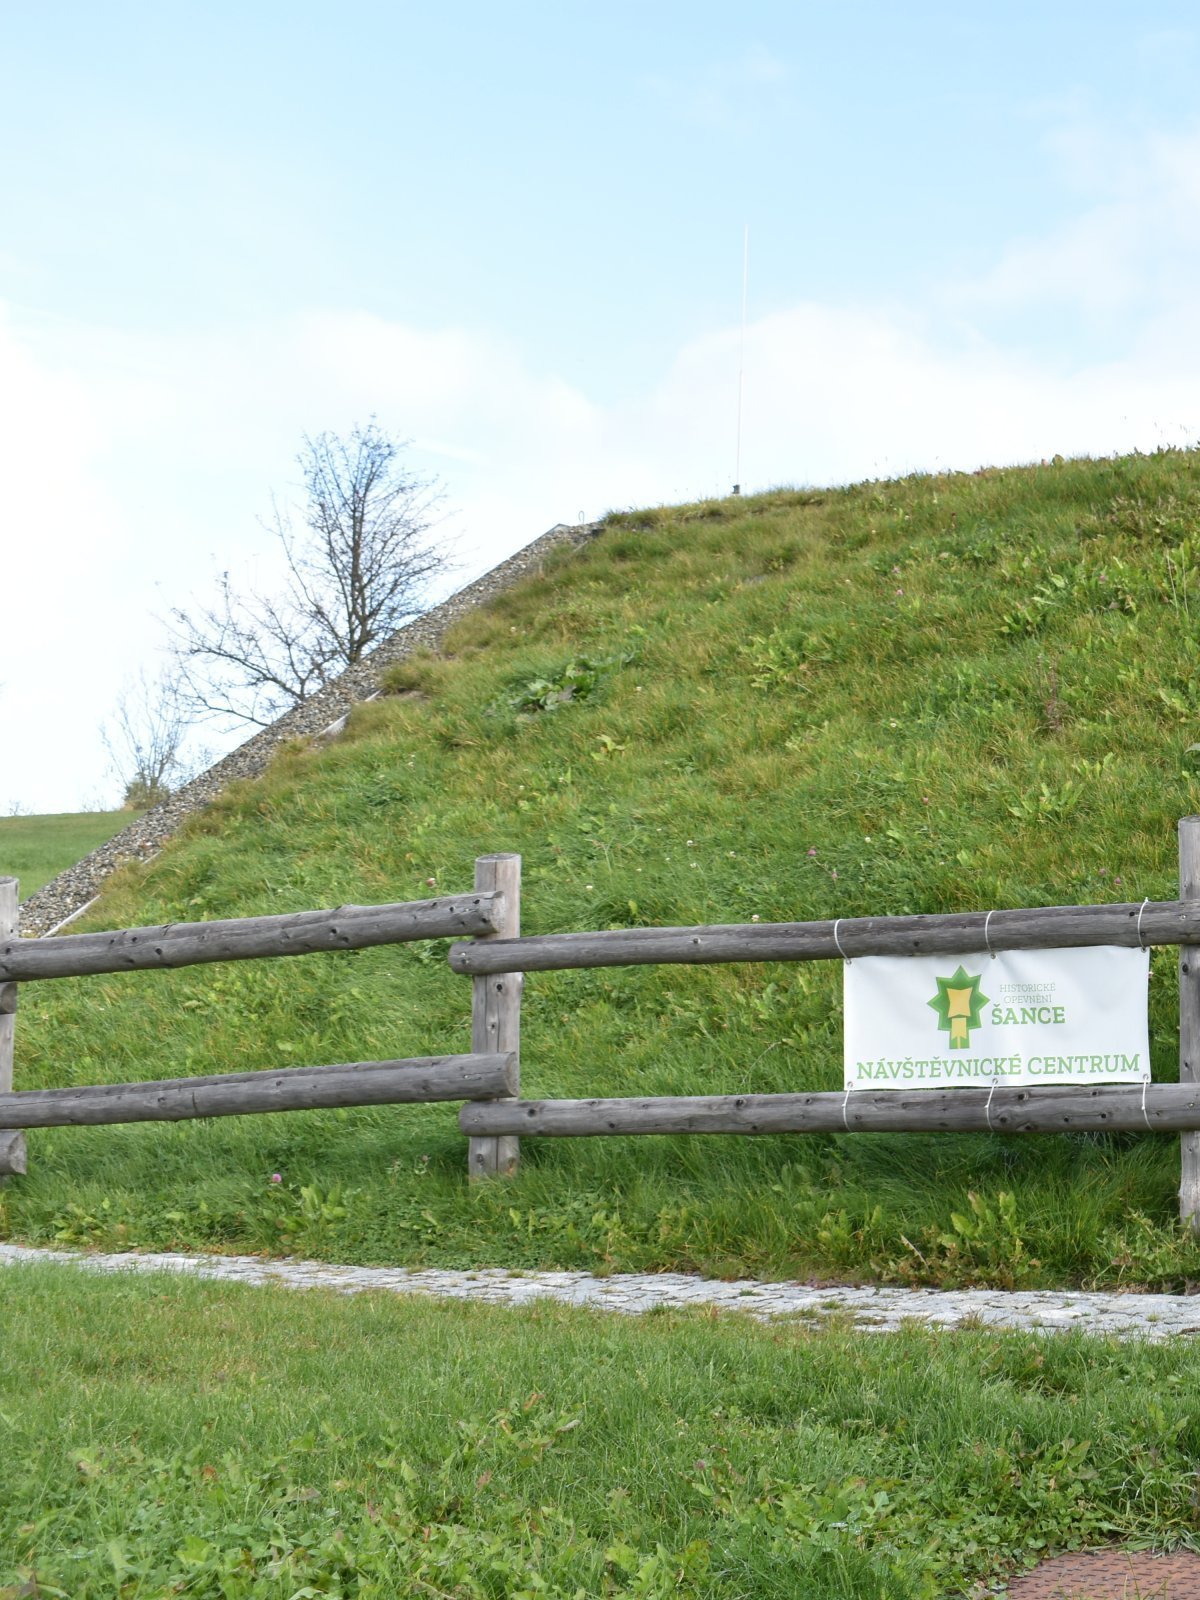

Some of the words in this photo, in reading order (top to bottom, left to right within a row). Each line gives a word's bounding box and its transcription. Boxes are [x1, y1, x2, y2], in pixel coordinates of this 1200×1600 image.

[999, 982, 1057, 993] HISTORICKÉ
[1003, 994, 1053, 1004] OPEVNĚNÍ
[991, 1003, 1066, 1026] ŠANCE
[856, 1054, 1022, 1080] NÁVŠTĚVNICKÉ
[1027, 1053, 1141, 1075] CENTRUM
